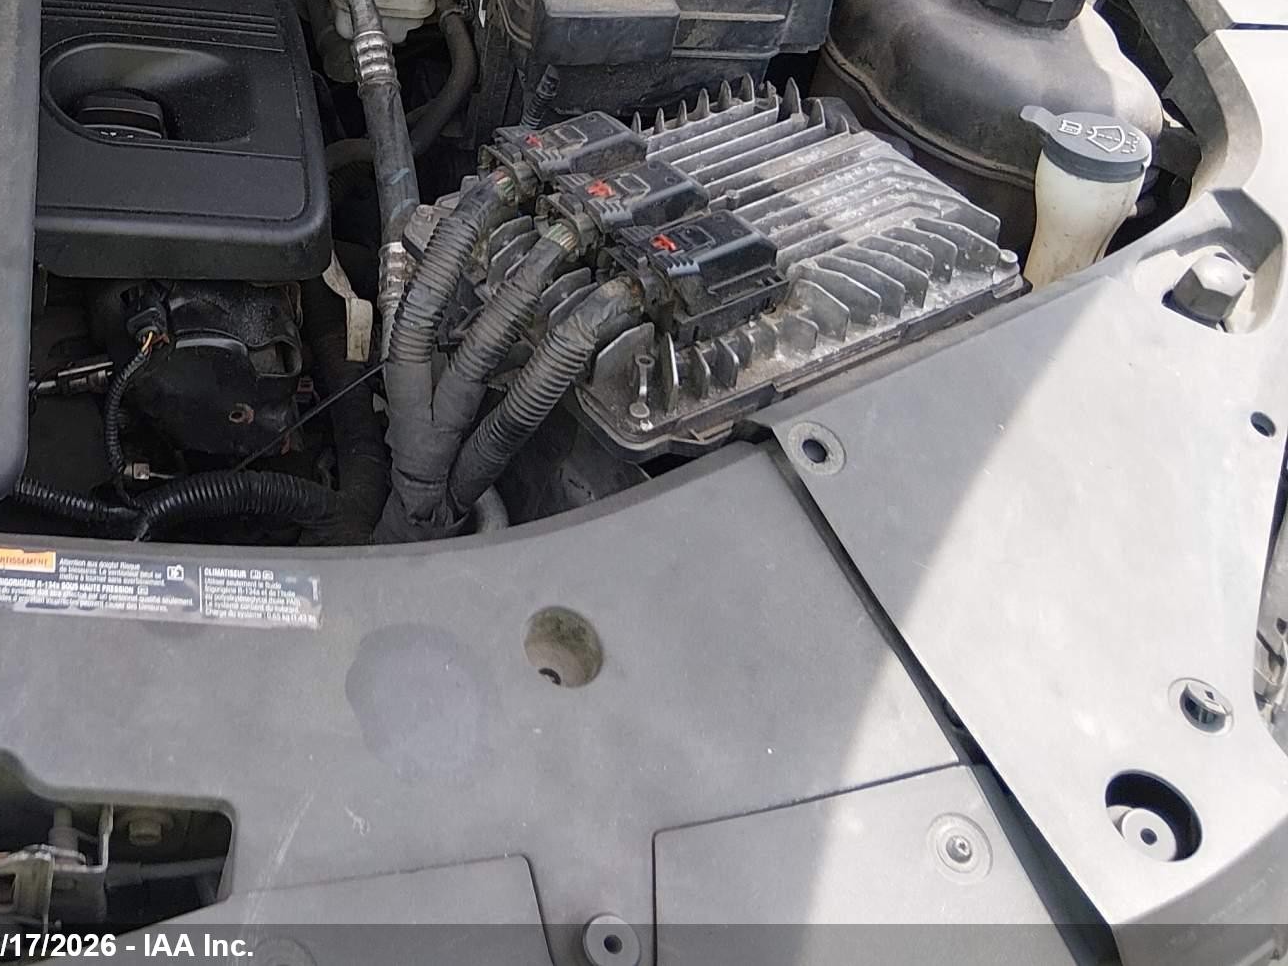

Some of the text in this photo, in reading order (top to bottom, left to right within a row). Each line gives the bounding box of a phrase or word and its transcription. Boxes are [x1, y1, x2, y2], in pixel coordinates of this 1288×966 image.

[204, 568, 247, 579] CLIMATISEUR
[79, 583, 101, 593] HAUTE
[101, 584, 134, 595] PRESSION
